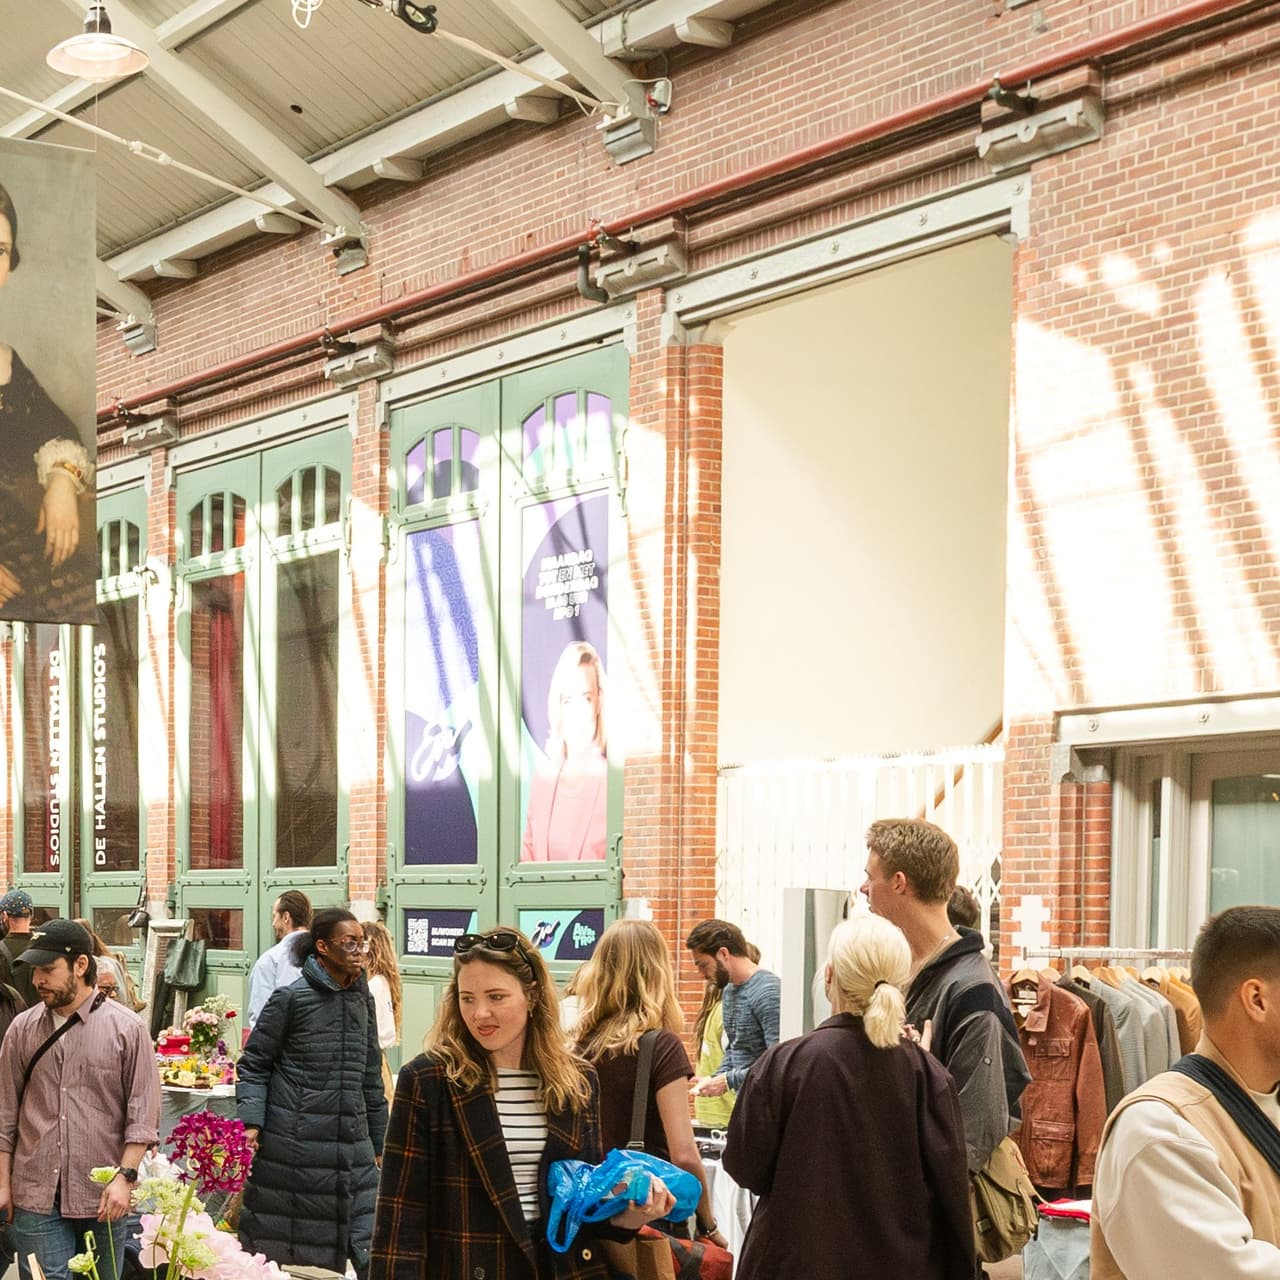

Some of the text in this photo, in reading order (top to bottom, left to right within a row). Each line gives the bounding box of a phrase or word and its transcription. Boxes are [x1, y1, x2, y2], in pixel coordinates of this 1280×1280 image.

[93, 643, 106, 865] DE HALLEN STUDIO'S
